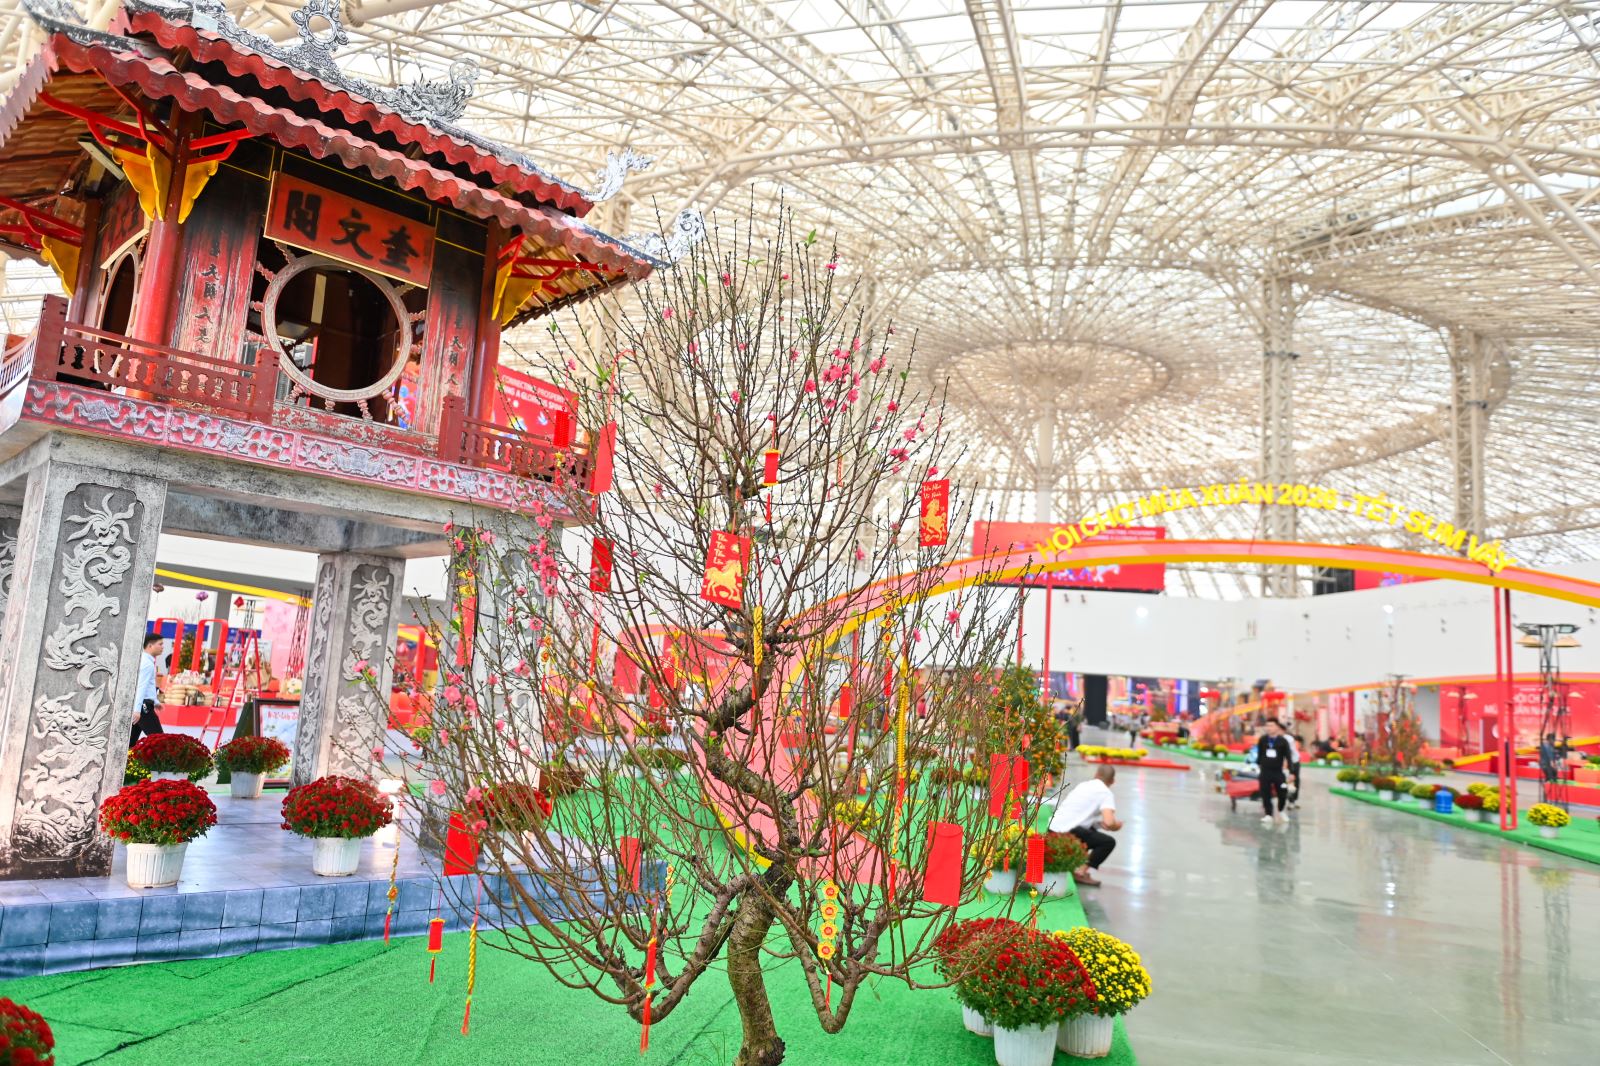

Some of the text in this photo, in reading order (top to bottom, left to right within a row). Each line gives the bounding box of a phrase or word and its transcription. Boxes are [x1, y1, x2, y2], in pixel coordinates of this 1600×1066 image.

[1036, 526, 1082, 560] HỘI
[1079, 501, 1134, 537] CHỢ
[1138, 485, 1197, 518] MÙA
[1200, 476, 1274, 505] XUÂN
[1277, 483, 1337, 510] 2026
[1353, 491, 1405, 526] TẾT
[1404, 511, 1467, 551] SUM
